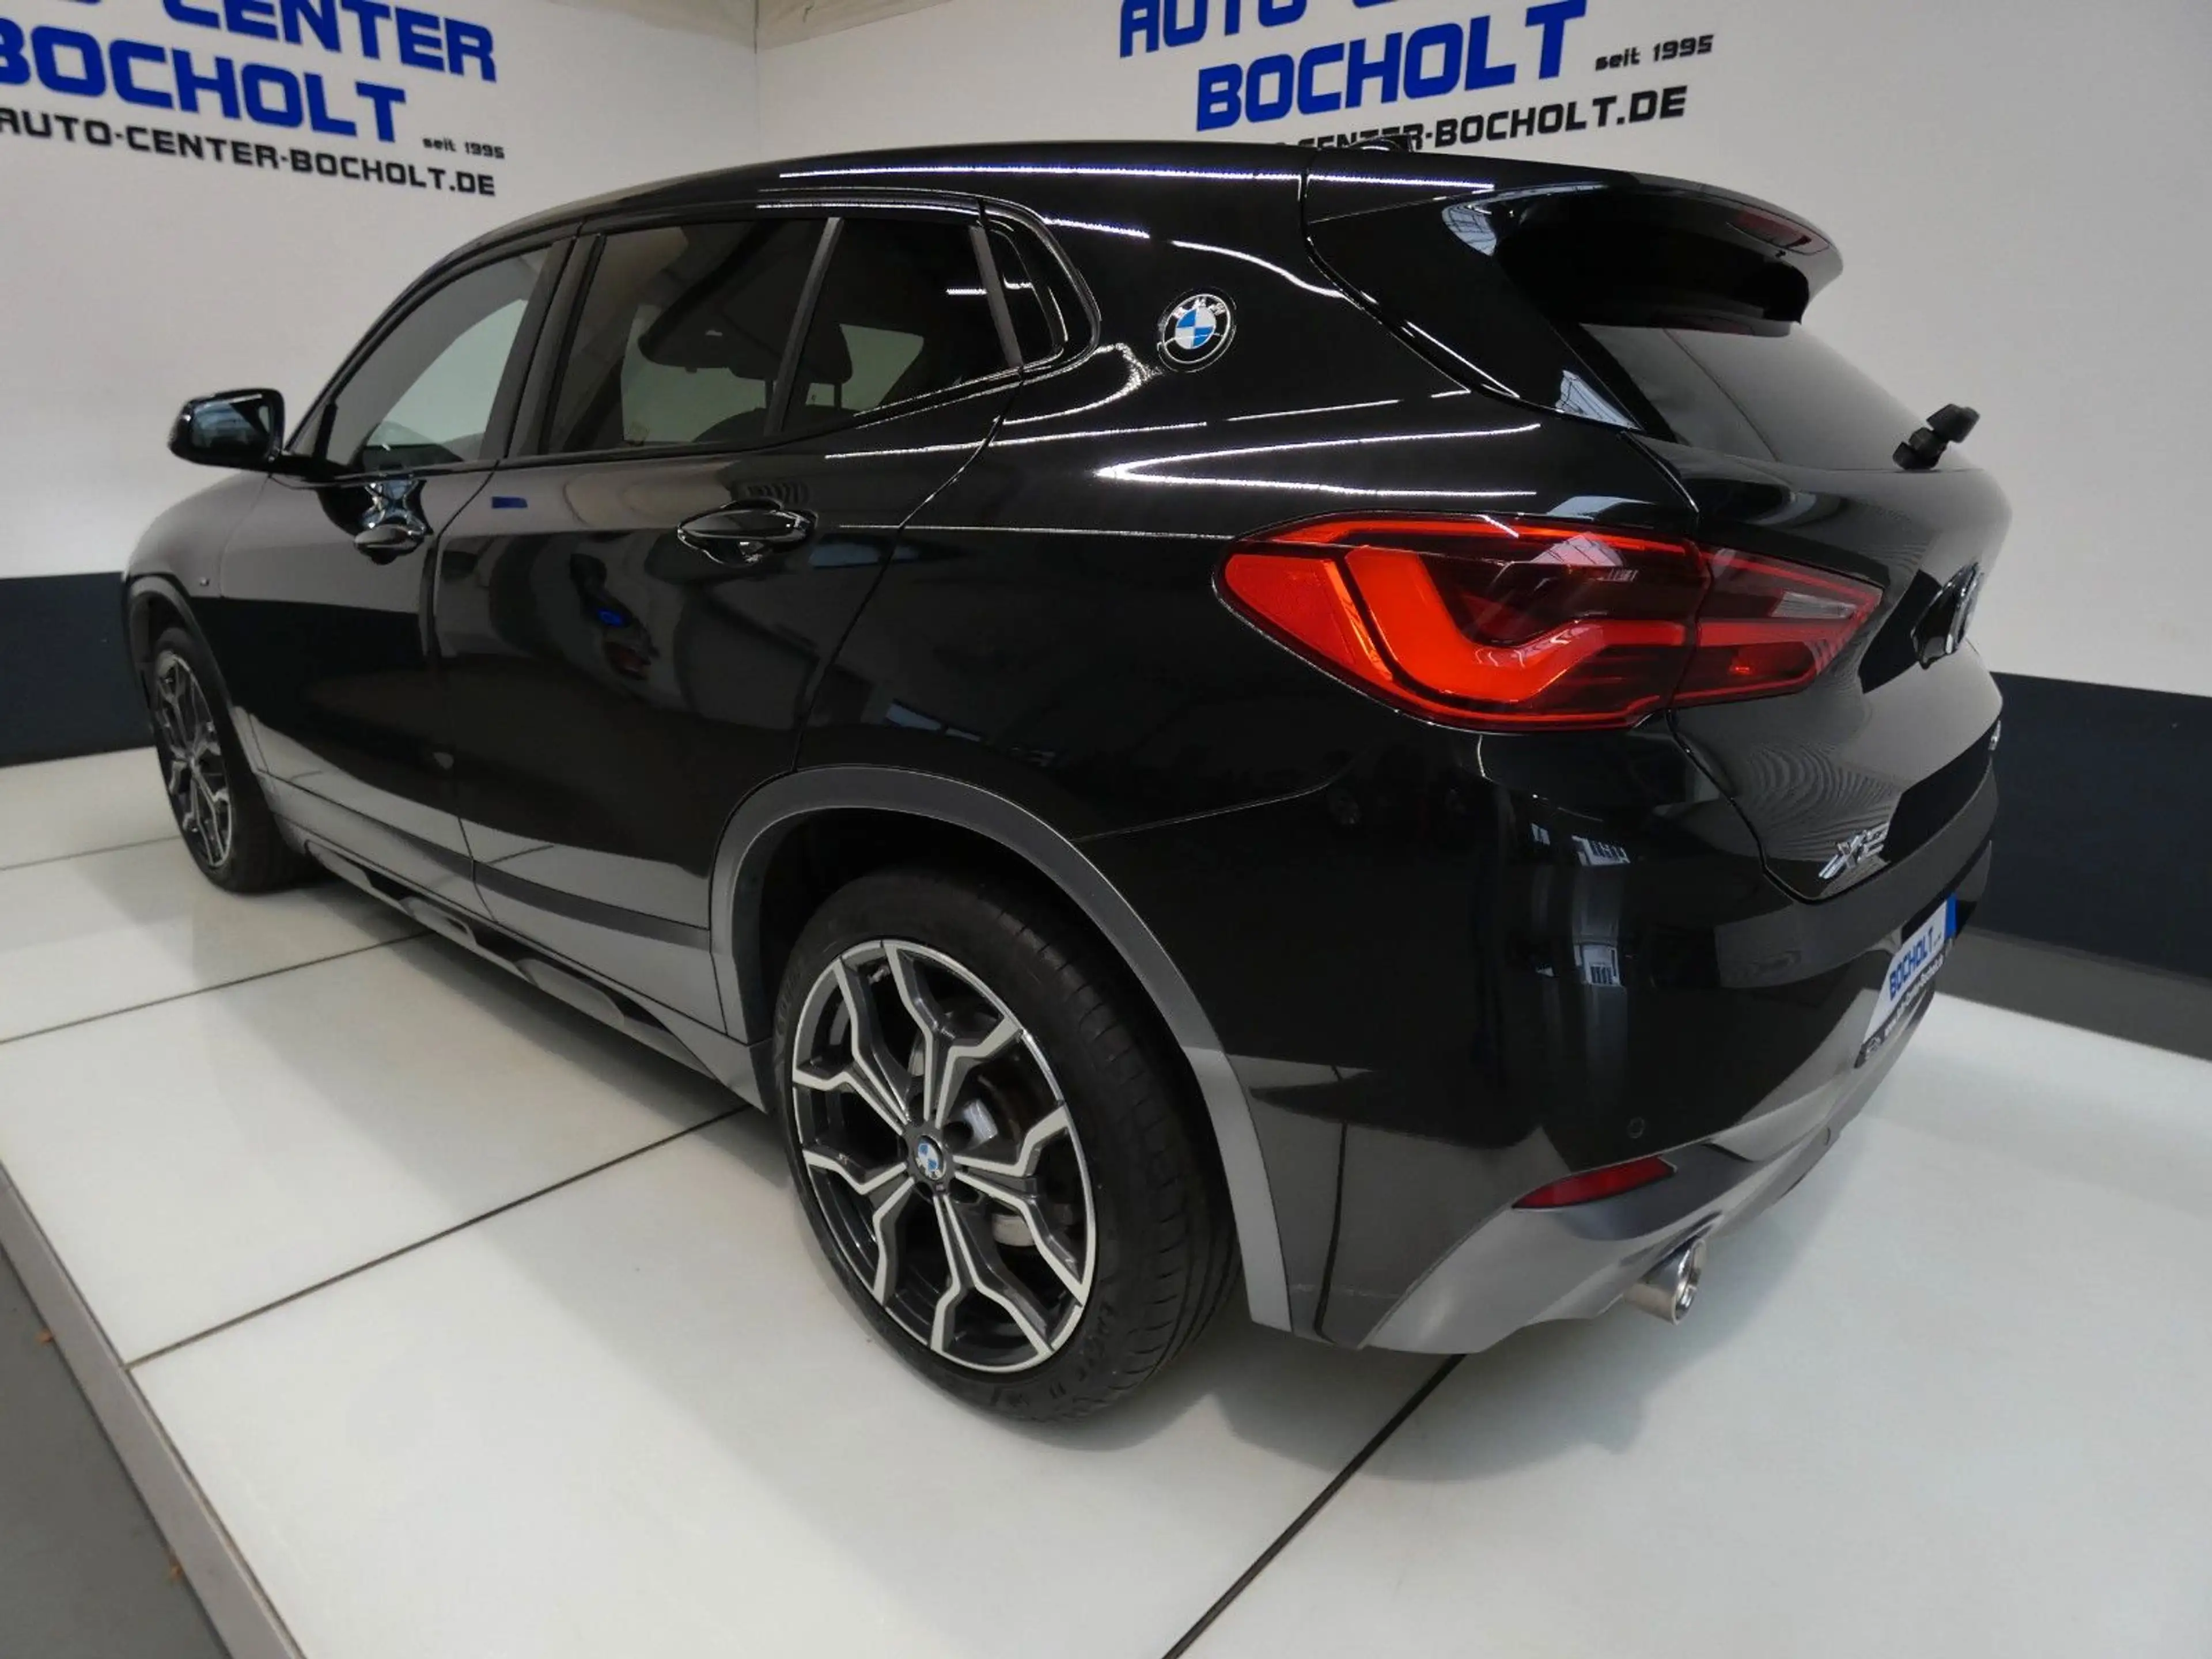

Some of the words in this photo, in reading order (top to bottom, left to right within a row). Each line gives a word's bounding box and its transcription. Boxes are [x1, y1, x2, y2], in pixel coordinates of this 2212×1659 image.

[1196, 0, 1588, 131] BOCHOLT
[1595, 47, 1641, 71] seit
[1653, 35, 1714, 62] 1995
[0, 107, 495, 196] AUTO-CENTER-BOCHOLT.DE
[465, 141, 505, 159] 1995
[1889, 925, 1934, 1001] BOCHOLT
